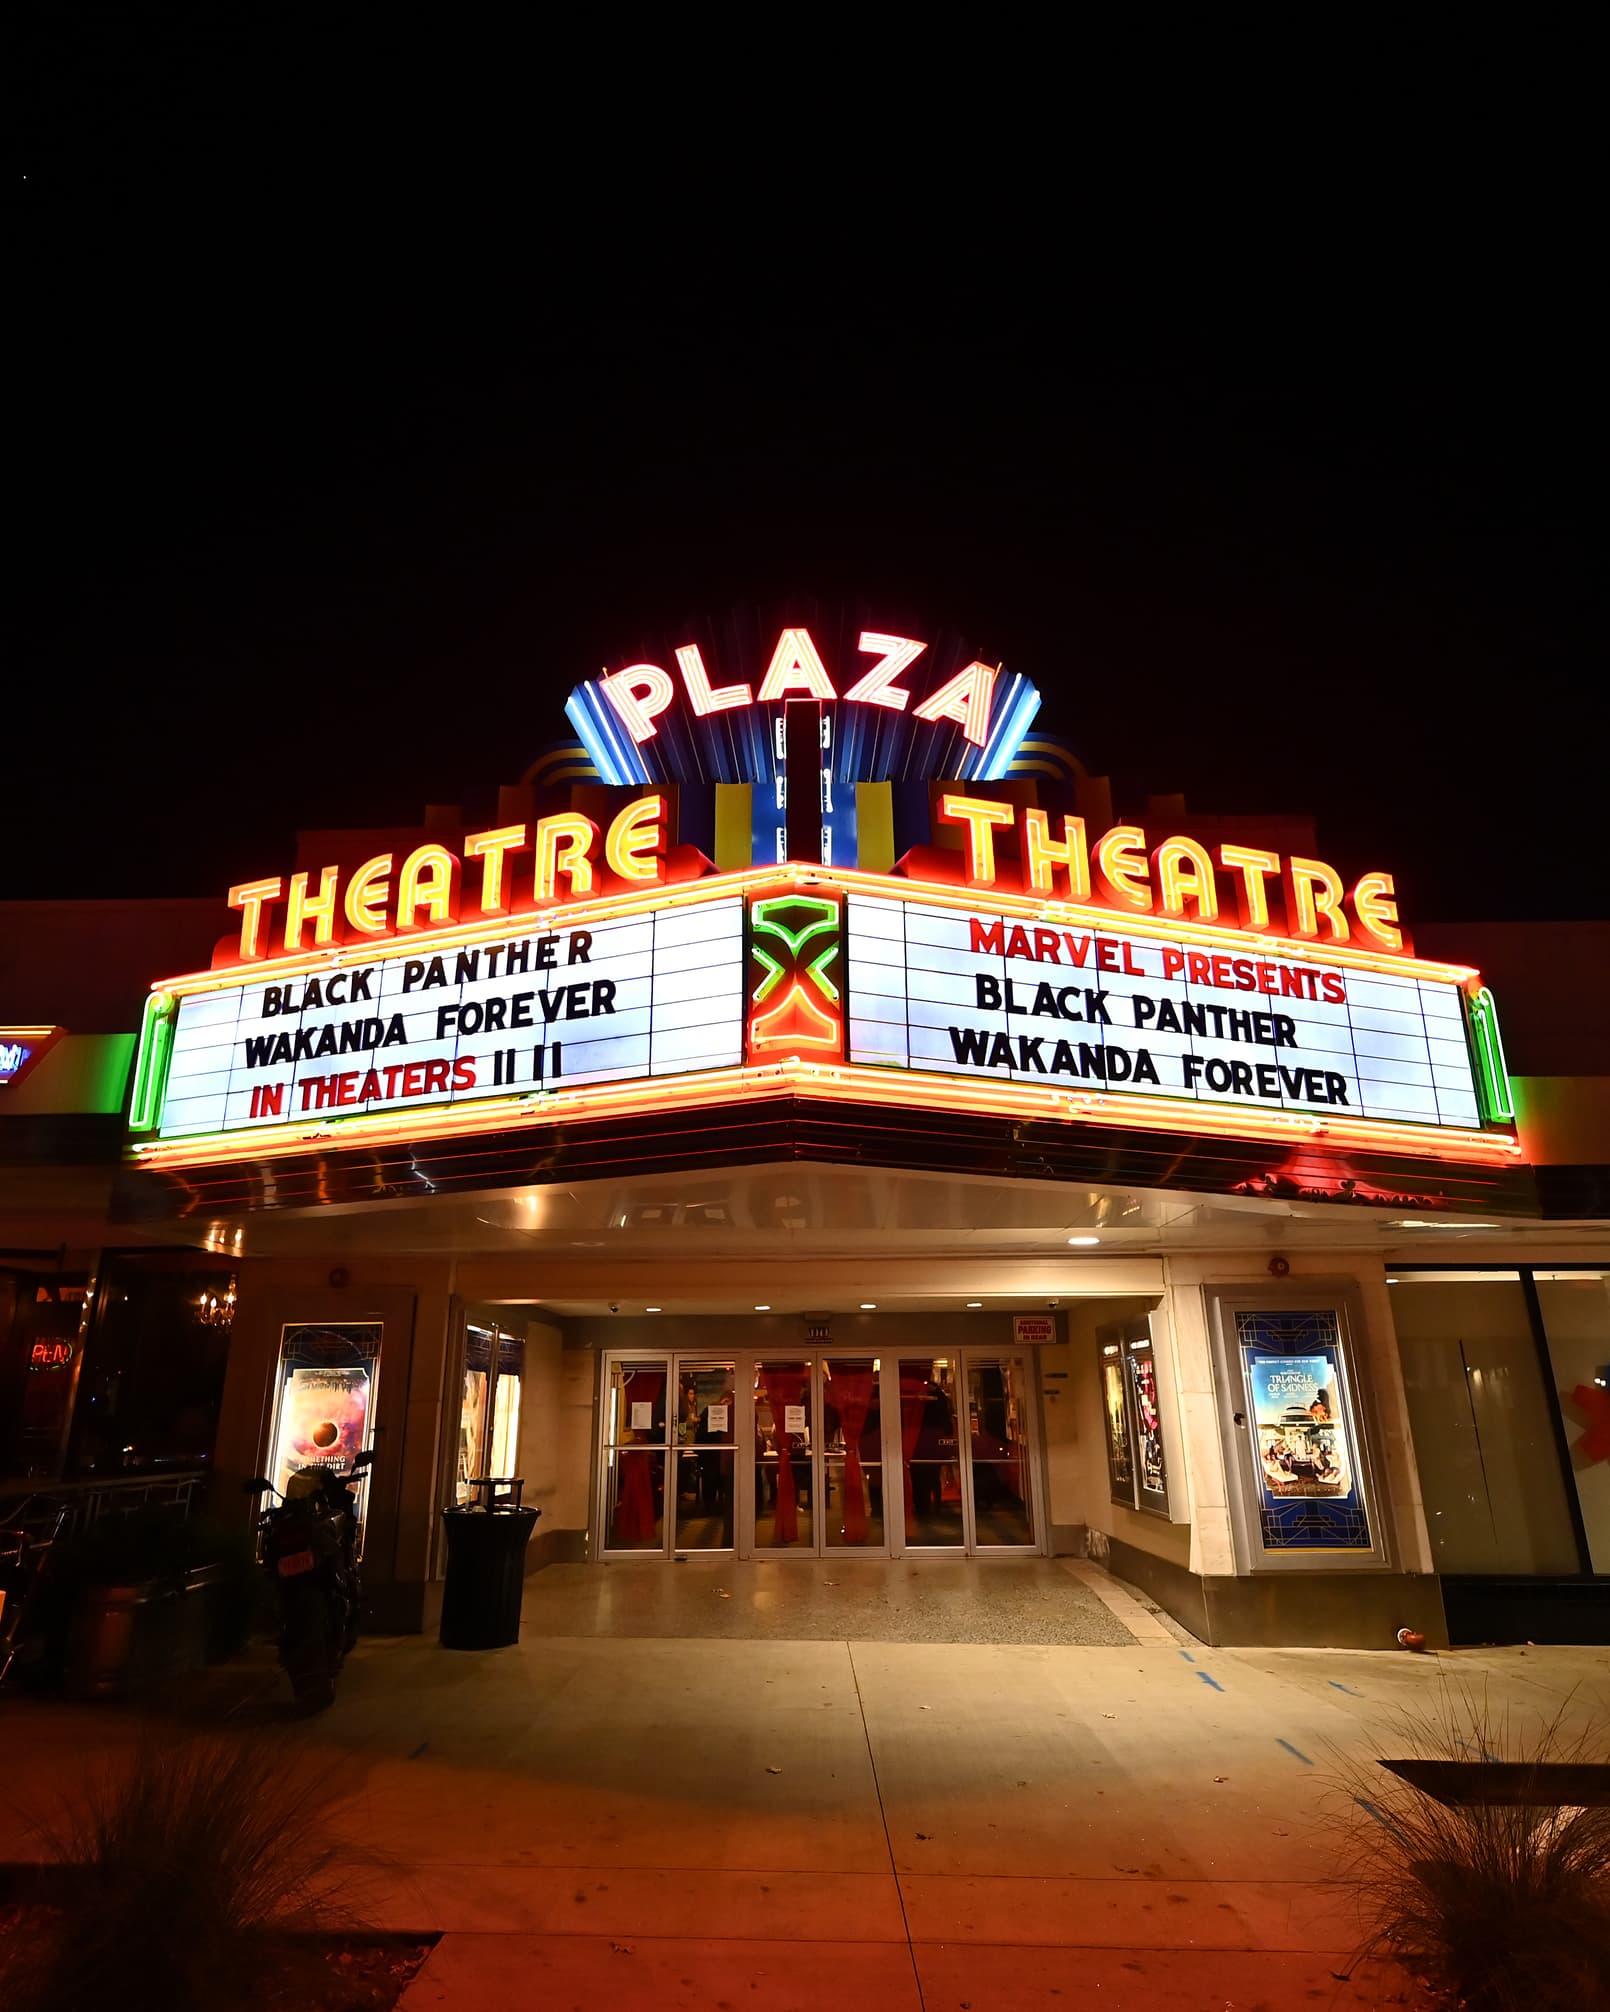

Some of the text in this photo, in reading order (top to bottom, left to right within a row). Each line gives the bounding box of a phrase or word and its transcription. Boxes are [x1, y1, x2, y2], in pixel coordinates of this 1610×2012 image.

[598, 627, 997, 748] PLAZA
[227, 794, 667, 962] THEATRE
[938, 794, 1405, 954] THEATRE
[261, 930, 593, 1018] BLACK PANTHER
[968, 917, 1347, 1005] MARVEL PRESENTS
[245, 979, 617, 1069] WAKANDA FOREVER
[975, 973, 1298, 1048] BLACK PANTHER
[249, 1082, 284, 1118] IN
[298, 1055, 477, 1112] THEATERS
[948, 1026, 1350, 1105] WAKANDA FOREVER
[1018, 1326, 1051, 1334] PARKING
[1267, 1382, 1319, 1392] OF SADNESS
[1269, 1374, 1314, 1384] TRIANGLE
